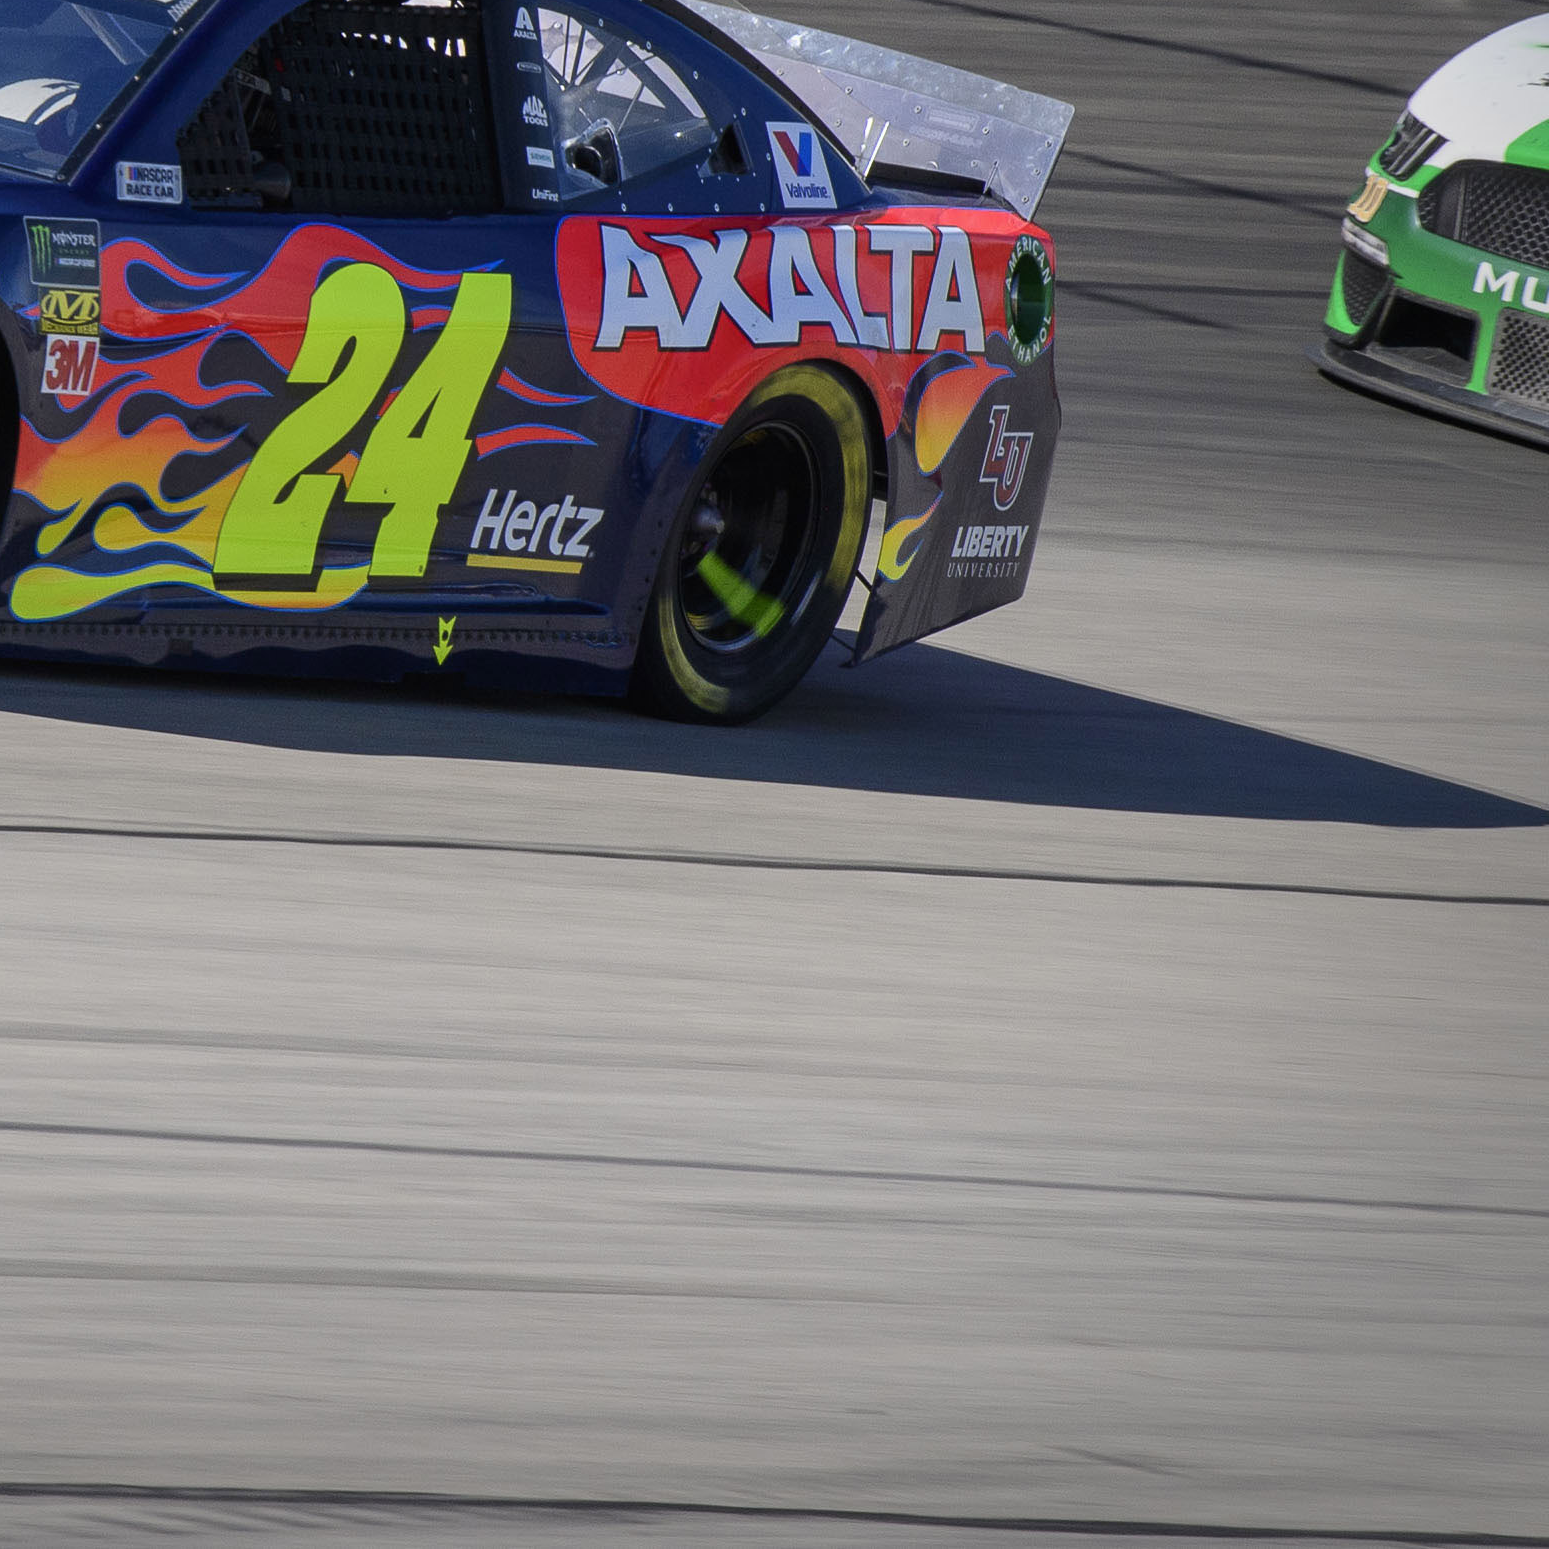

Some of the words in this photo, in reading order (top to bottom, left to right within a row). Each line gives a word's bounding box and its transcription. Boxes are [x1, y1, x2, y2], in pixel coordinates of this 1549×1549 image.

[126, 183, 152, 197] RACE
[154, 185, 174, 198] CAR
[135, 166, 174, 183] NASCAR
[785, 182, 829, 199] Valvoline
[51, 231, 97, 247] MONSTER
[1005, 236, 1052, 290] AMERICAN
[595, 222, 988, 353] AXALTA
[1007, 315, 1052, 363] ETHANOL
[46, 338, 97, 392] 3M
[213, 263, 512, 582] 24
[470, 488, 604, 557] Hertz
[951, 526, 1029, 558] LIBERTY
[947, 562, 1020, 579] UNIVERSITY
